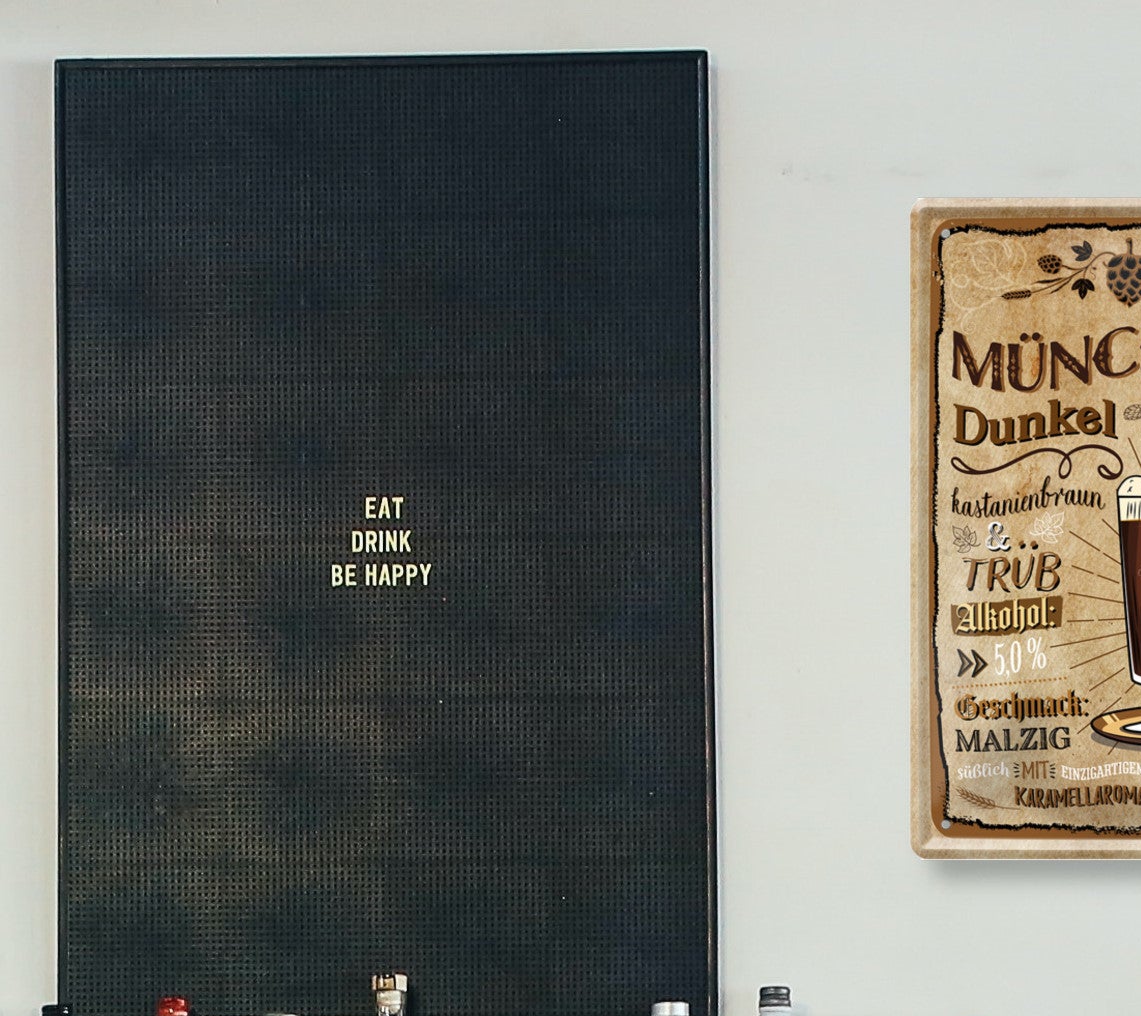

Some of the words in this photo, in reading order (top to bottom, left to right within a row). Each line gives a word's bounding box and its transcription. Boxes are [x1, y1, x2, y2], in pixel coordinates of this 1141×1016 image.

[953, 399, 1118, 446] Dunkel
[365, 496, 404, 519] EAT
[951, 476, 1106, 518] kastanienbraun
[351, 529, 412, 553] DRINK
[985, 521, 1010, 551] &
[331, 563, 357, 587] BE
[365, 563, 432, 586] HAPPY
[962, 540, 1062, 592] TRÜB
[955, 602, 1057, 632] Alkohol:
[954, 690, 1090, 721] Geschmack:
[955, 727, 1071, 753] MALZIG
[957, 761, 1010, 781] süßlich
[1021, 760, 1049, 780] MIT
